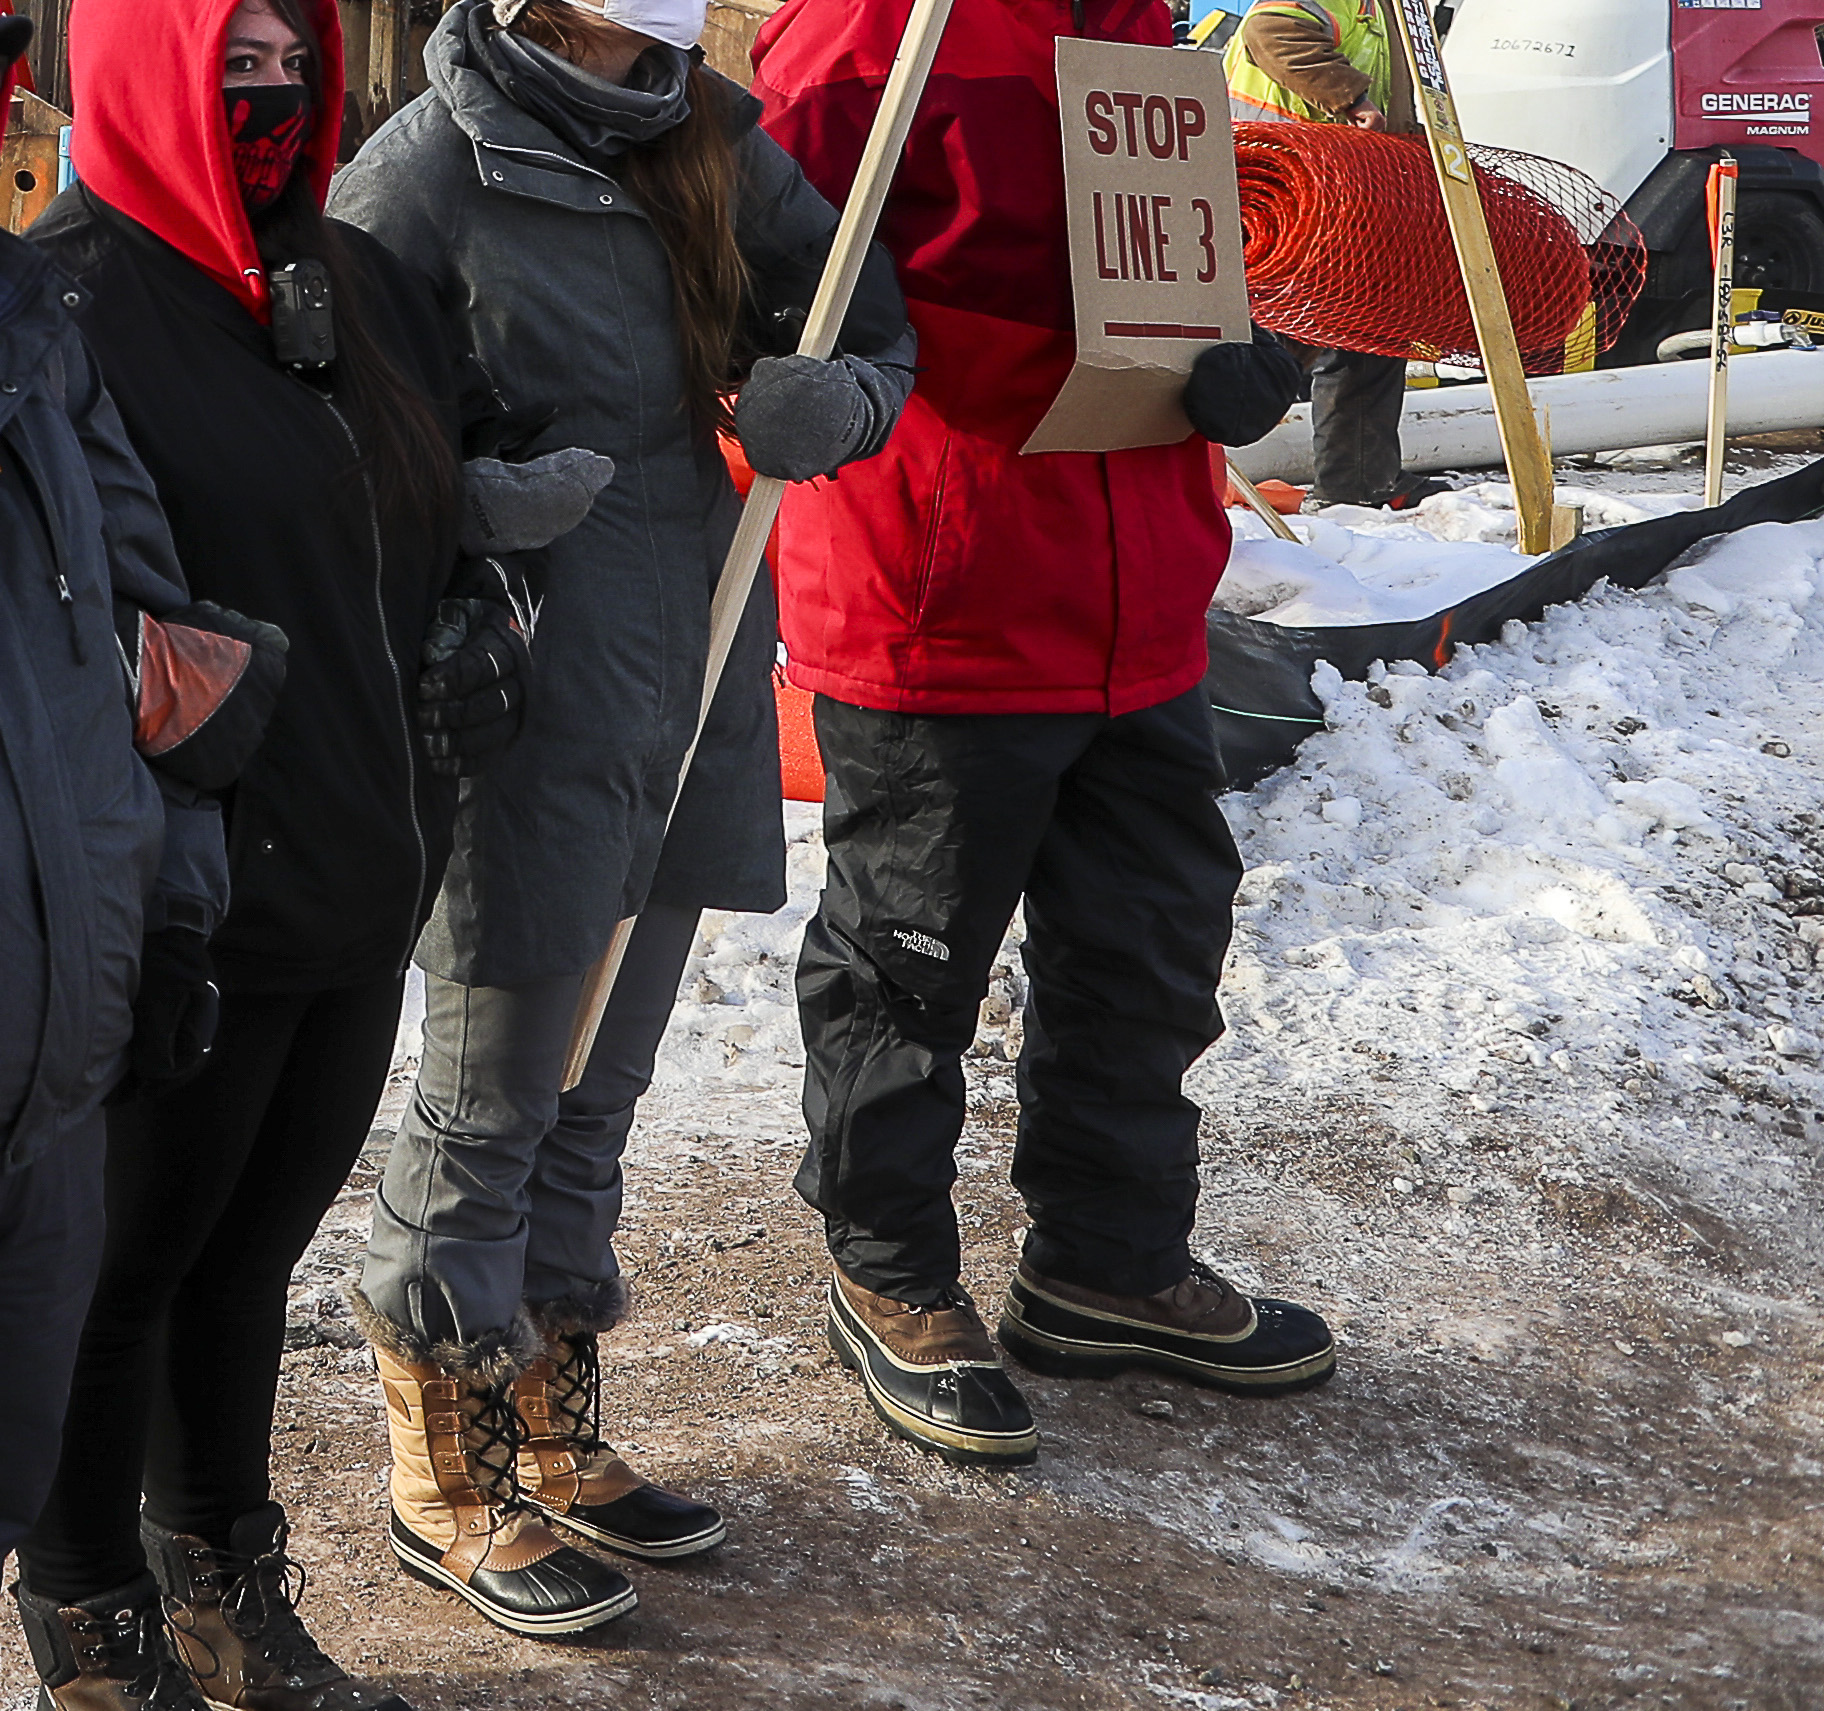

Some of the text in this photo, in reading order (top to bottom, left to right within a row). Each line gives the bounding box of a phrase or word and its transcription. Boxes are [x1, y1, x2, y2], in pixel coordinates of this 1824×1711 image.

[1701, 93, 1810, 111] GENERAC
[1085, 89, 1207, 163] STOP
[1746, 126, 1810, 136] MAGNUM
[1092, 191, 1217, 284] LINE 3
[1721, 211, 1734, 250] L3R
[892, 929, 932, 948] NORTH
[912, 929, 933, 944] THE
[901, 939, 930, 957] FACE
